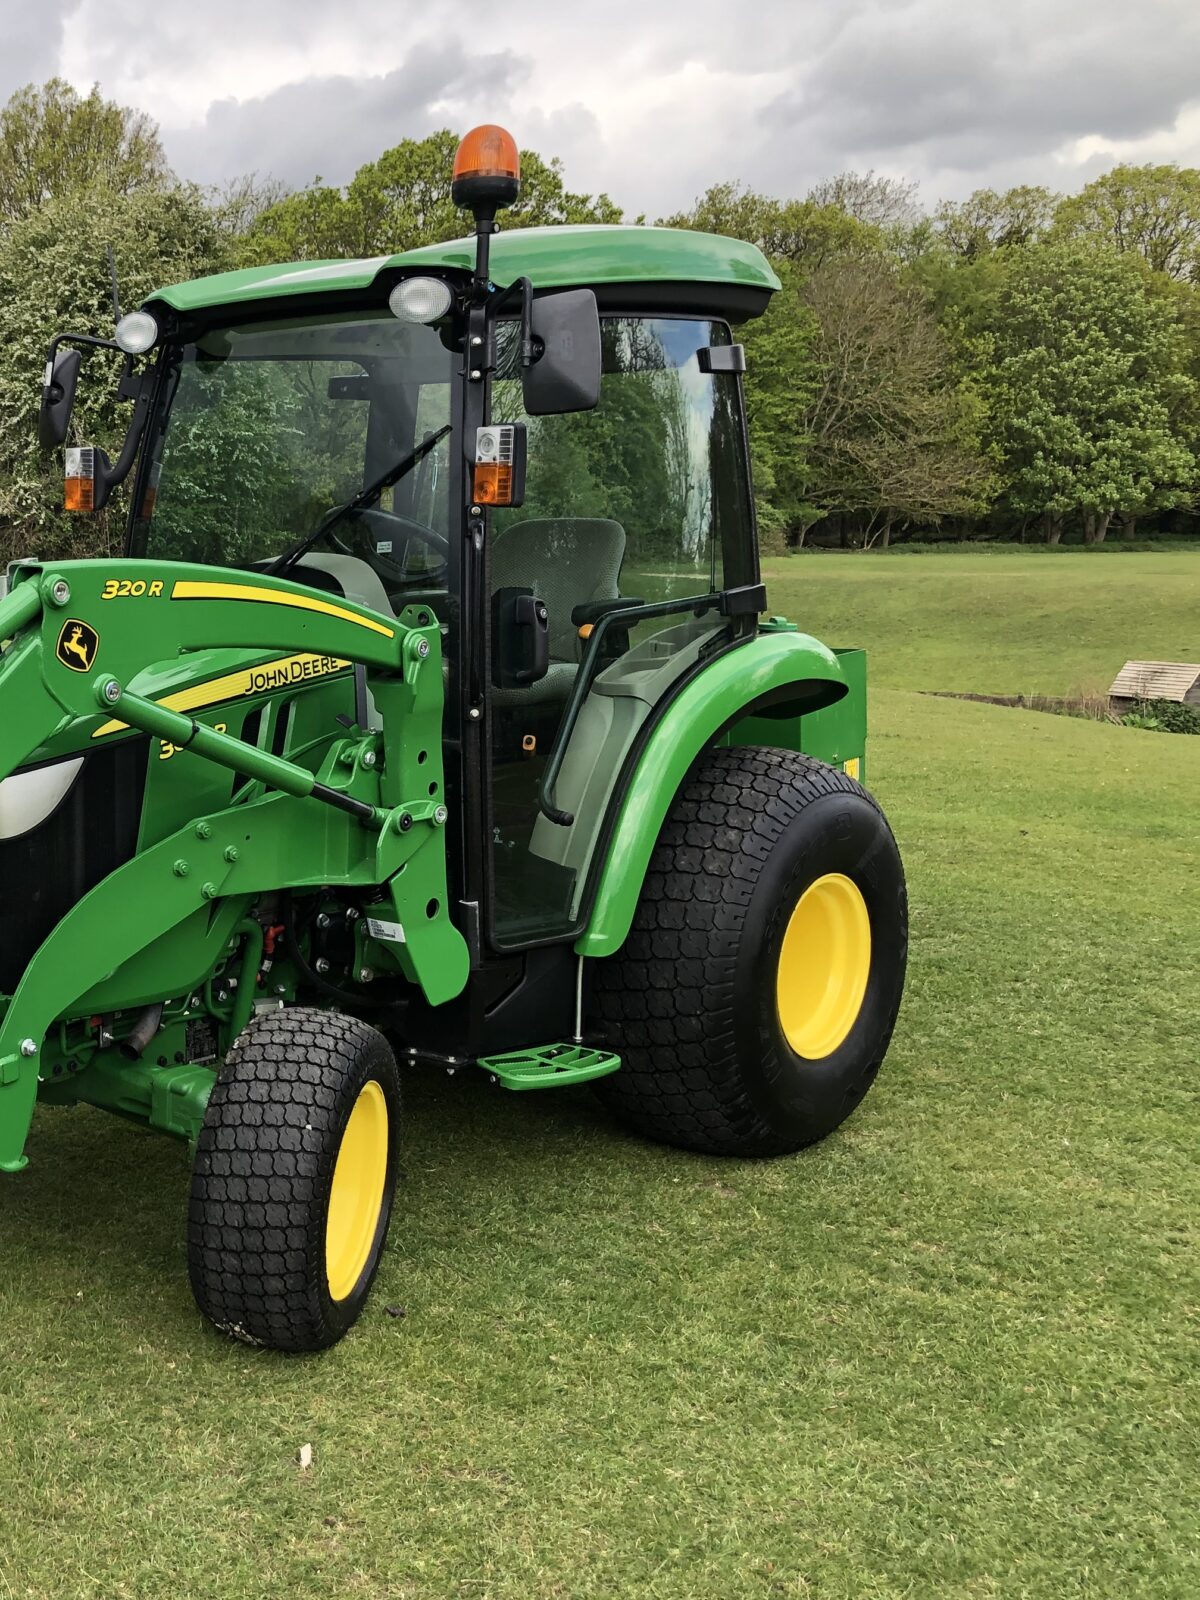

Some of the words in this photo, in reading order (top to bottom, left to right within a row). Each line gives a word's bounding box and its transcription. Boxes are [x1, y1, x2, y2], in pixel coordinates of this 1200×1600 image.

[101, 579, 147, 600] 320
[148, 580, 164, 597] R
[245, 666, 289, 693] JOHN
[291, 656, 339, 680] DEERE
